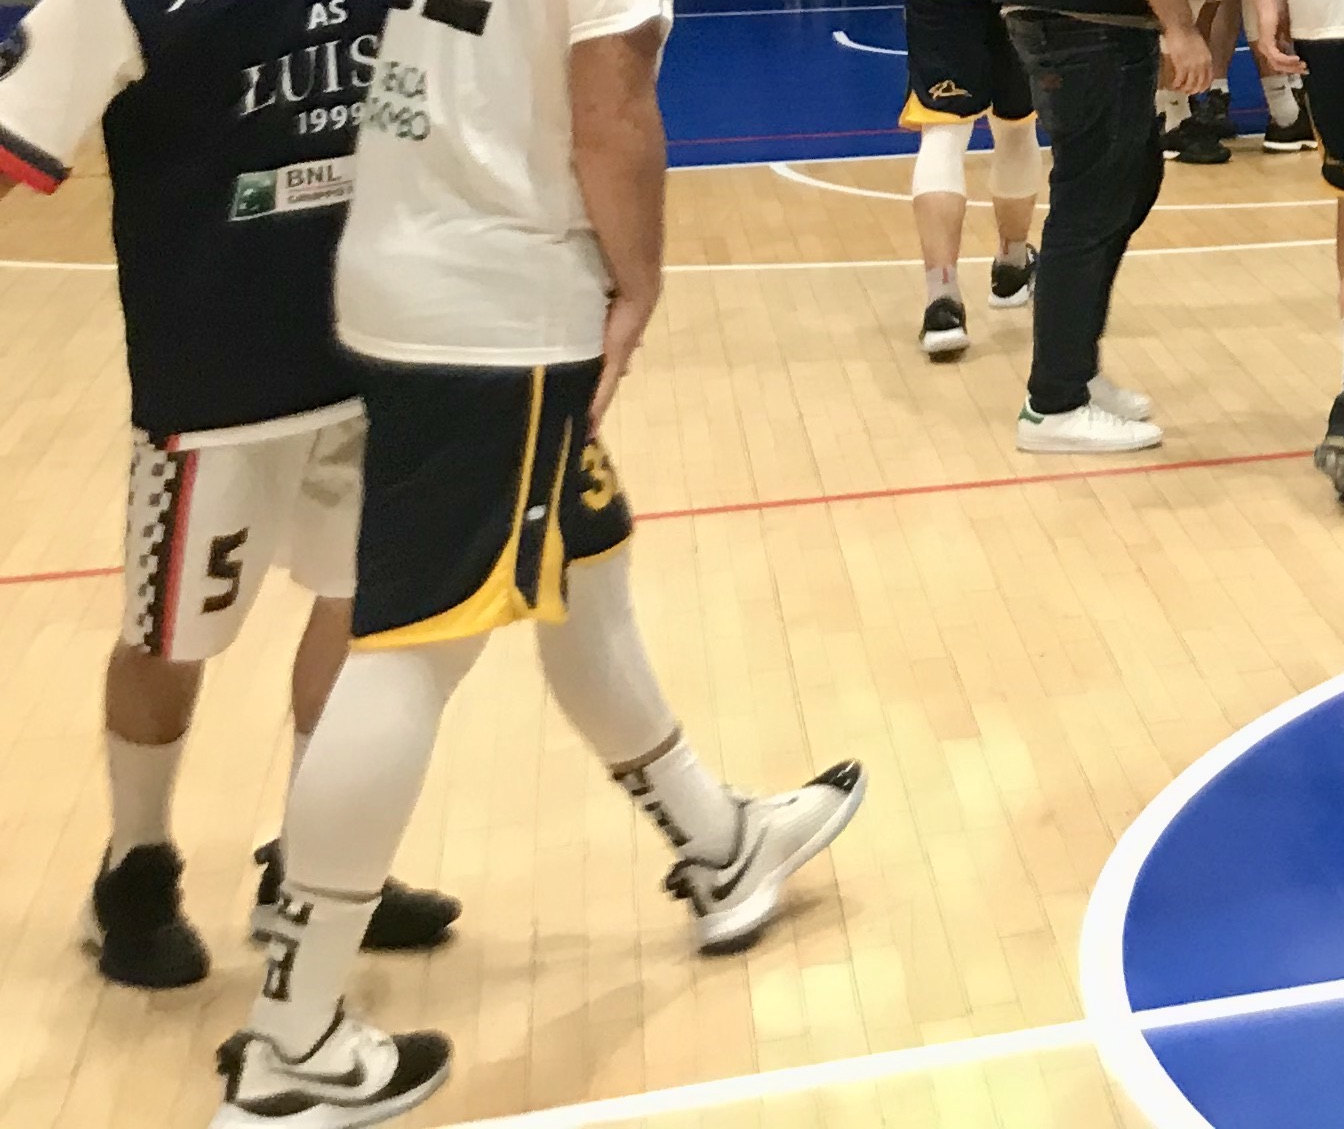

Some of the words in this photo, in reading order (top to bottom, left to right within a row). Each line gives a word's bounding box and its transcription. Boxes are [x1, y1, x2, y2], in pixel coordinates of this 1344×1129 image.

[239, 33, 379, 117] LUIS
[286, 164, 342, 189] BNL
[201, 526, 250, 614] 5
